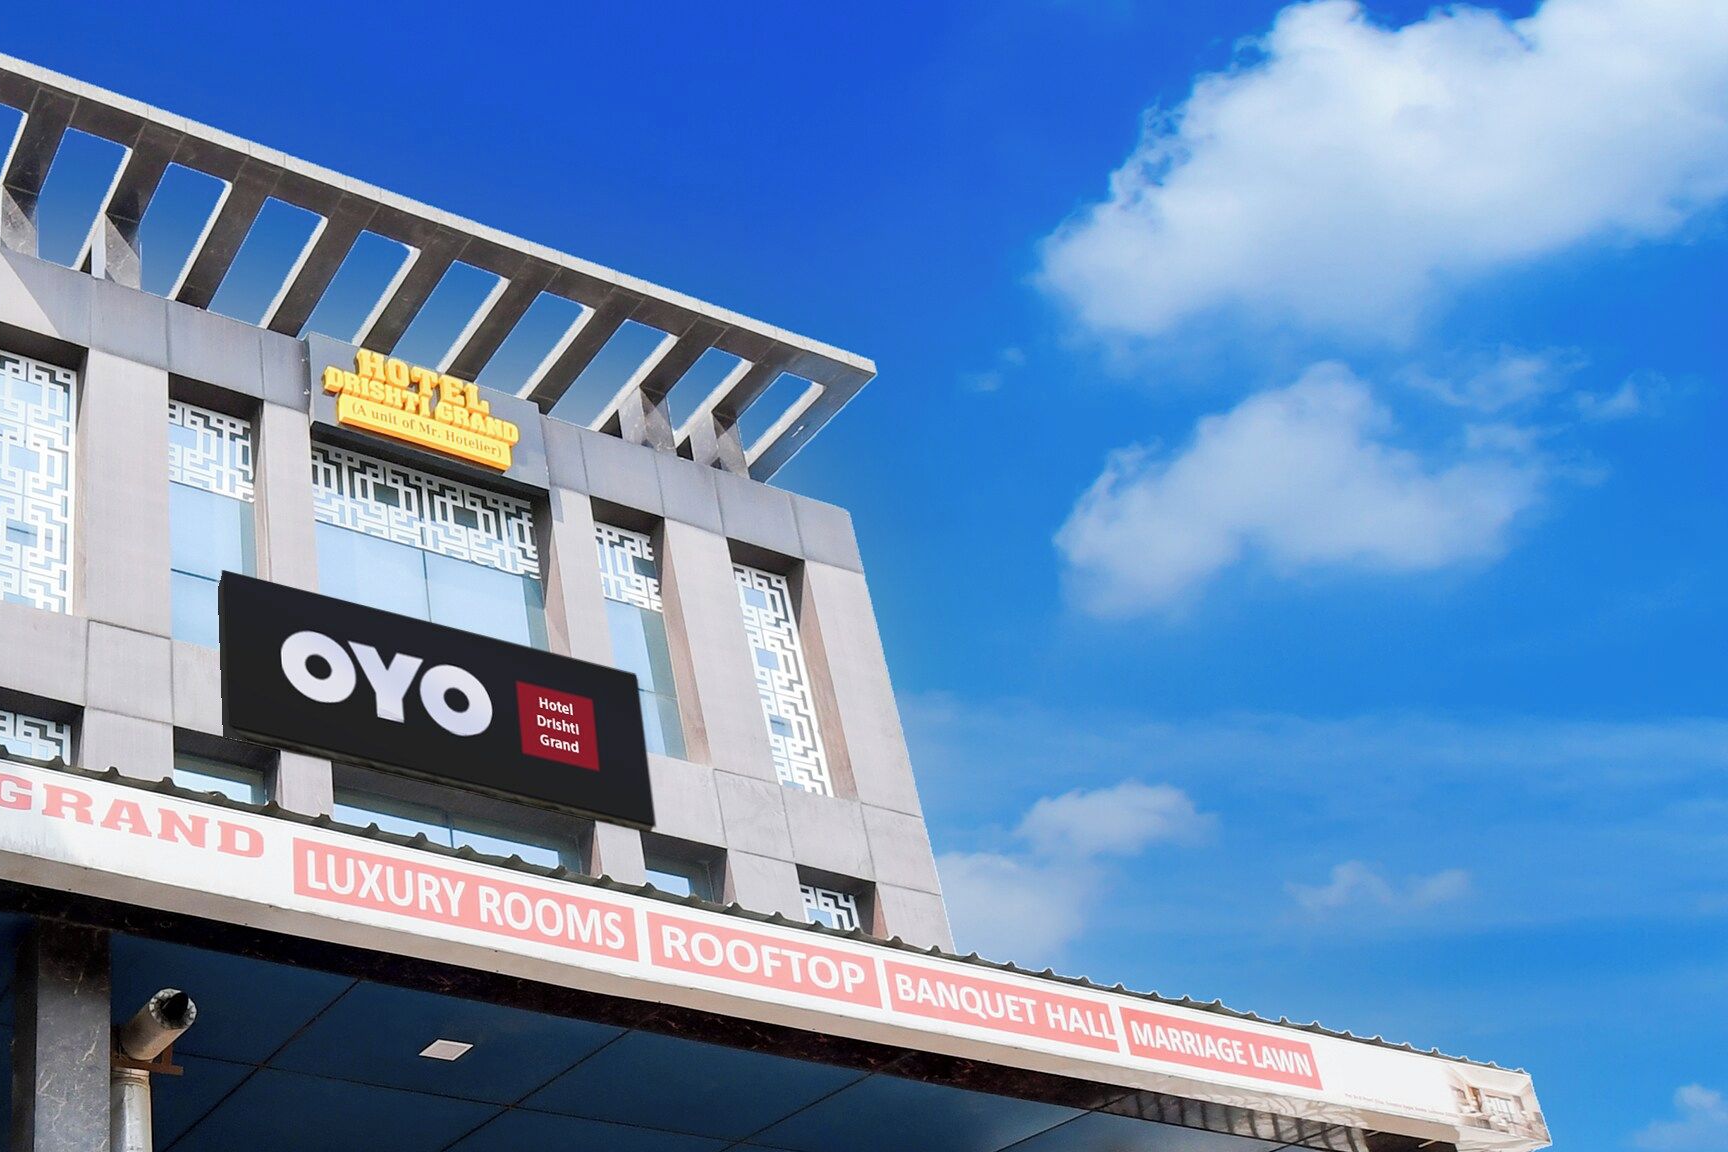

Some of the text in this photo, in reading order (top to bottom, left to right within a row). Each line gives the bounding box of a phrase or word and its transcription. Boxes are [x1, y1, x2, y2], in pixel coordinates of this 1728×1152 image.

[324, 365, 519, 445] DRISHTI GRAND
[356, 348, 490, 415] HOTEL
[352, 402, 503, 458] (A unit of Mr. Hotelier)
[280, 630, 493, 737] OYO
[538, 696, 574, 716] Hotel
[539, 733, 580, 754] Grand
[305, 849, 626, 950] LUXURY ROOMS
[663, 924, 867, 995] ROOFTOP
[894, 972, 1117, 1042] BANQUET HALL
[1130, 1019, 1314, 1078] MARRIAGE LAWN
